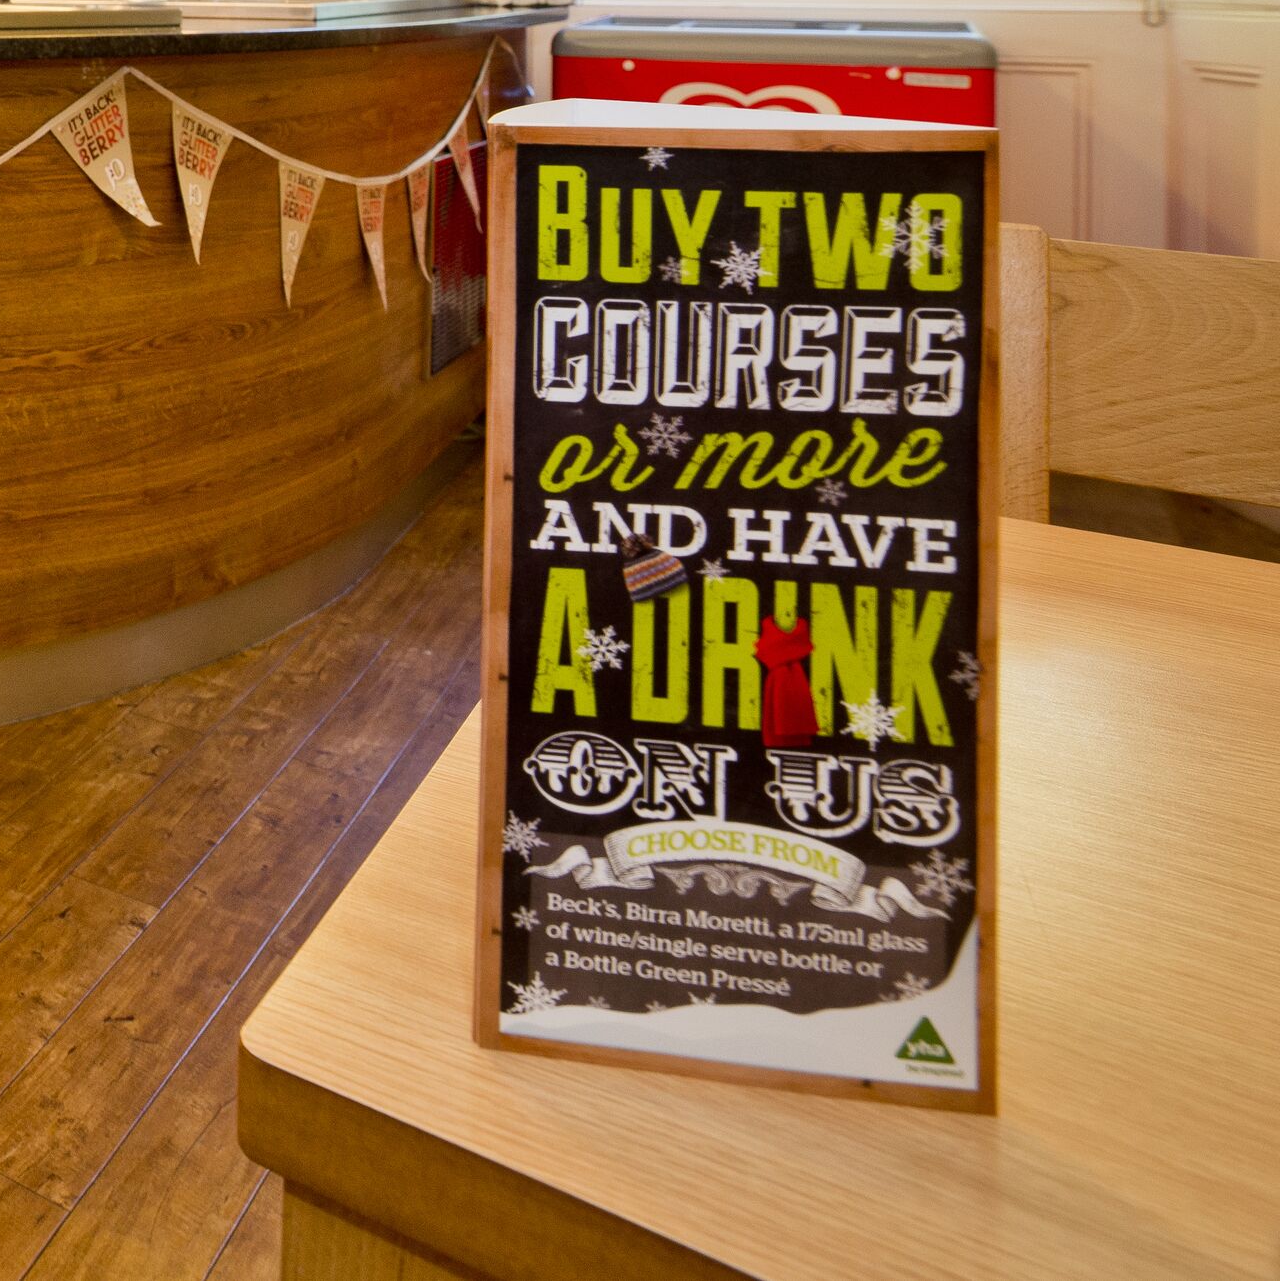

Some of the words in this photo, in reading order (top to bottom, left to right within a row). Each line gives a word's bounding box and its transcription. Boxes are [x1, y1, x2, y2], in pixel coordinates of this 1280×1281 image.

[68, 115, 84, 133] IT'S
[85, 89, 115, 120] BACK!
[73, 104, 122, 148] GLITTER
[80, 119, 124, 166] BERRY
[538, 165, 722, 285] BUY
[745, 191, 963, 292] TWO
[533, 296, 967, 417] COURSES
[539, 424, 655, 493] or
[674, 418, 948, 491] more
[529, 499, 708, 557] AND
[727, 508, 957, 574] HAVE
[531, 567, 599, 718] A
[631, 577, 955, 747] DRINK
[524, 730, 738, 823] ON
[766, 751, 961, 847] US
[627, 829, 747, 857] CHOOSE
[753, 834, 840, 878] FROM
[545, 921, 571, 941] of
[575, 926, 707, 959] wine/single
[711, 945, 778, 966] serve
[781, 948, 851, 974] bottle
[856, 961, 883, 978] or
[546, 892, 621, 919] Beck's,
[625, 902, 681, 927] Birra
[780, 925, 794, 939] a
[798, 921, 864, 947] 175ml
[868, 930, 928, 955] glass
[545, 954, 560, 968] a
[564, 951, 631, 976] Bottle
[635, 959, 707, 986] Green
[713, 969, 791, 996] Pressé
